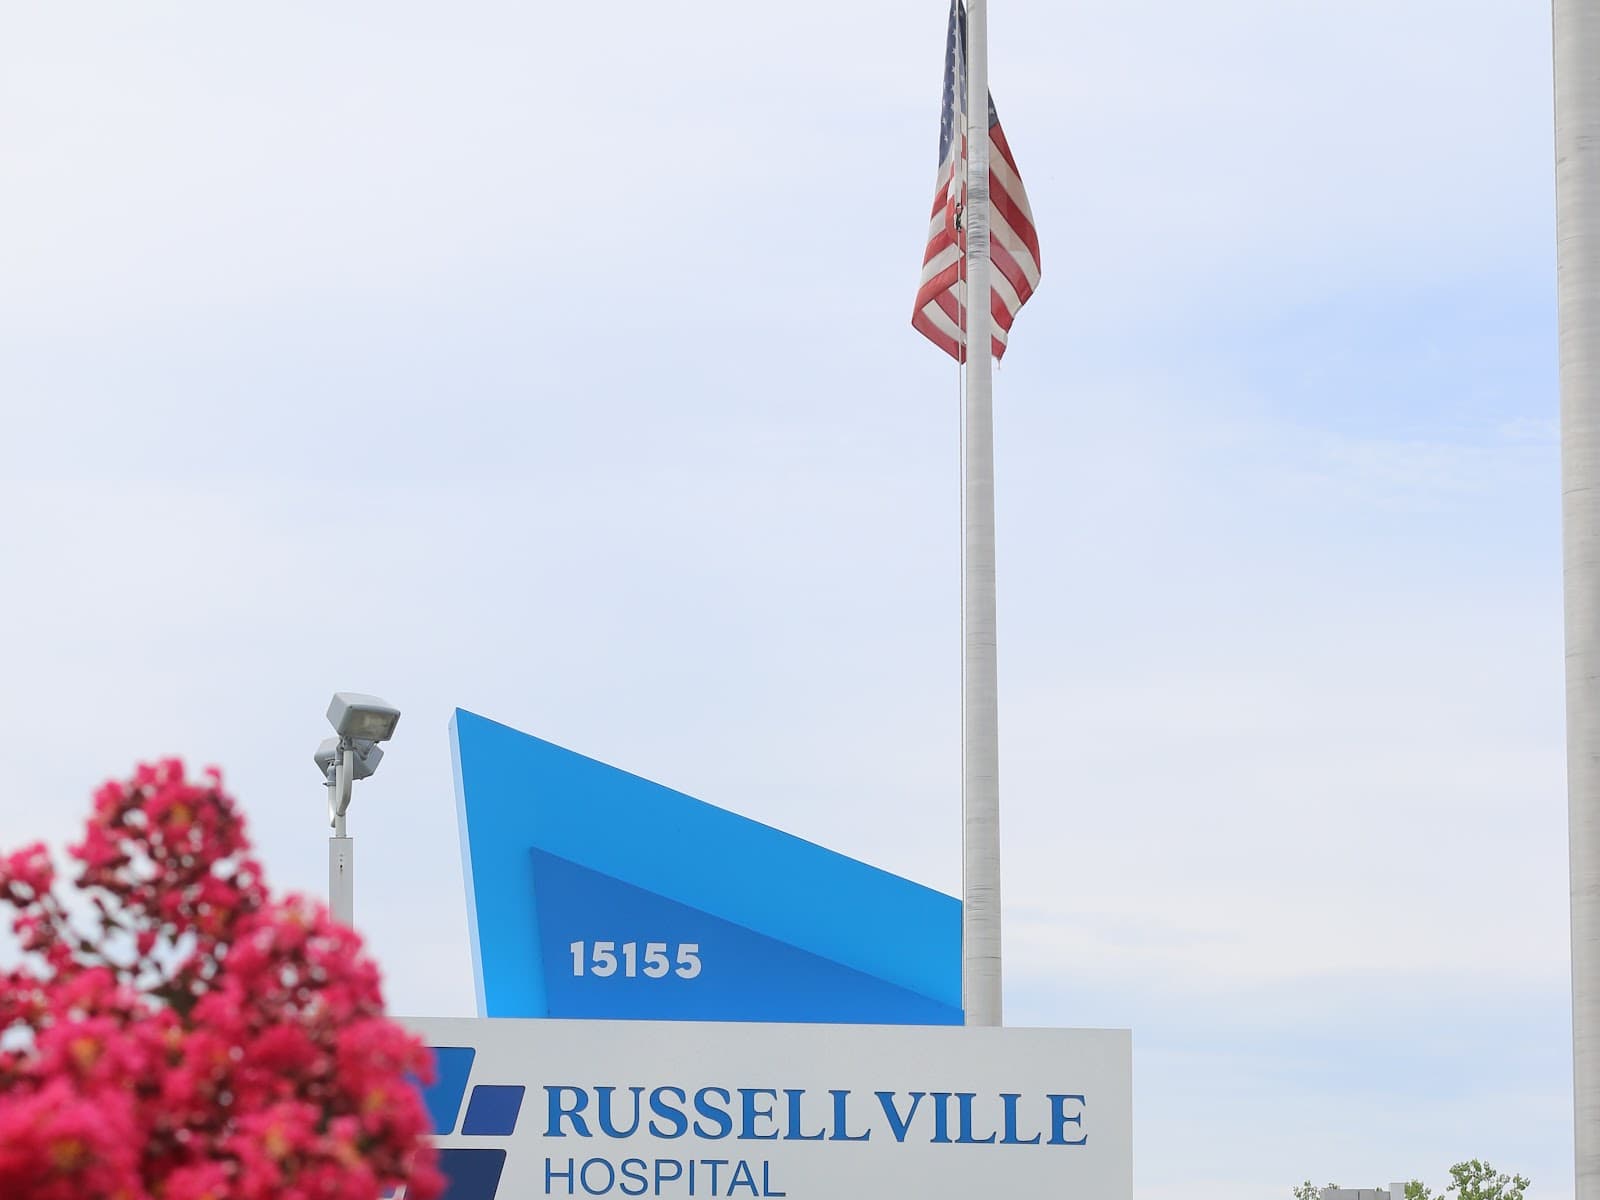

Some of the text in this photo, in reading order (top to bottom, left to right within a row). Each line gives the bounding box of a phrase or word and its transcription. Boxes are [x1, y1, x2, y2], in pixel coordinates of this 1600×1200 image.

[569, 941, 703, 980] 15155
[542, 1085, 1089, 1146] RUSSELLVILLE
[544, 1156, 787, 1197] HOSPITAL
